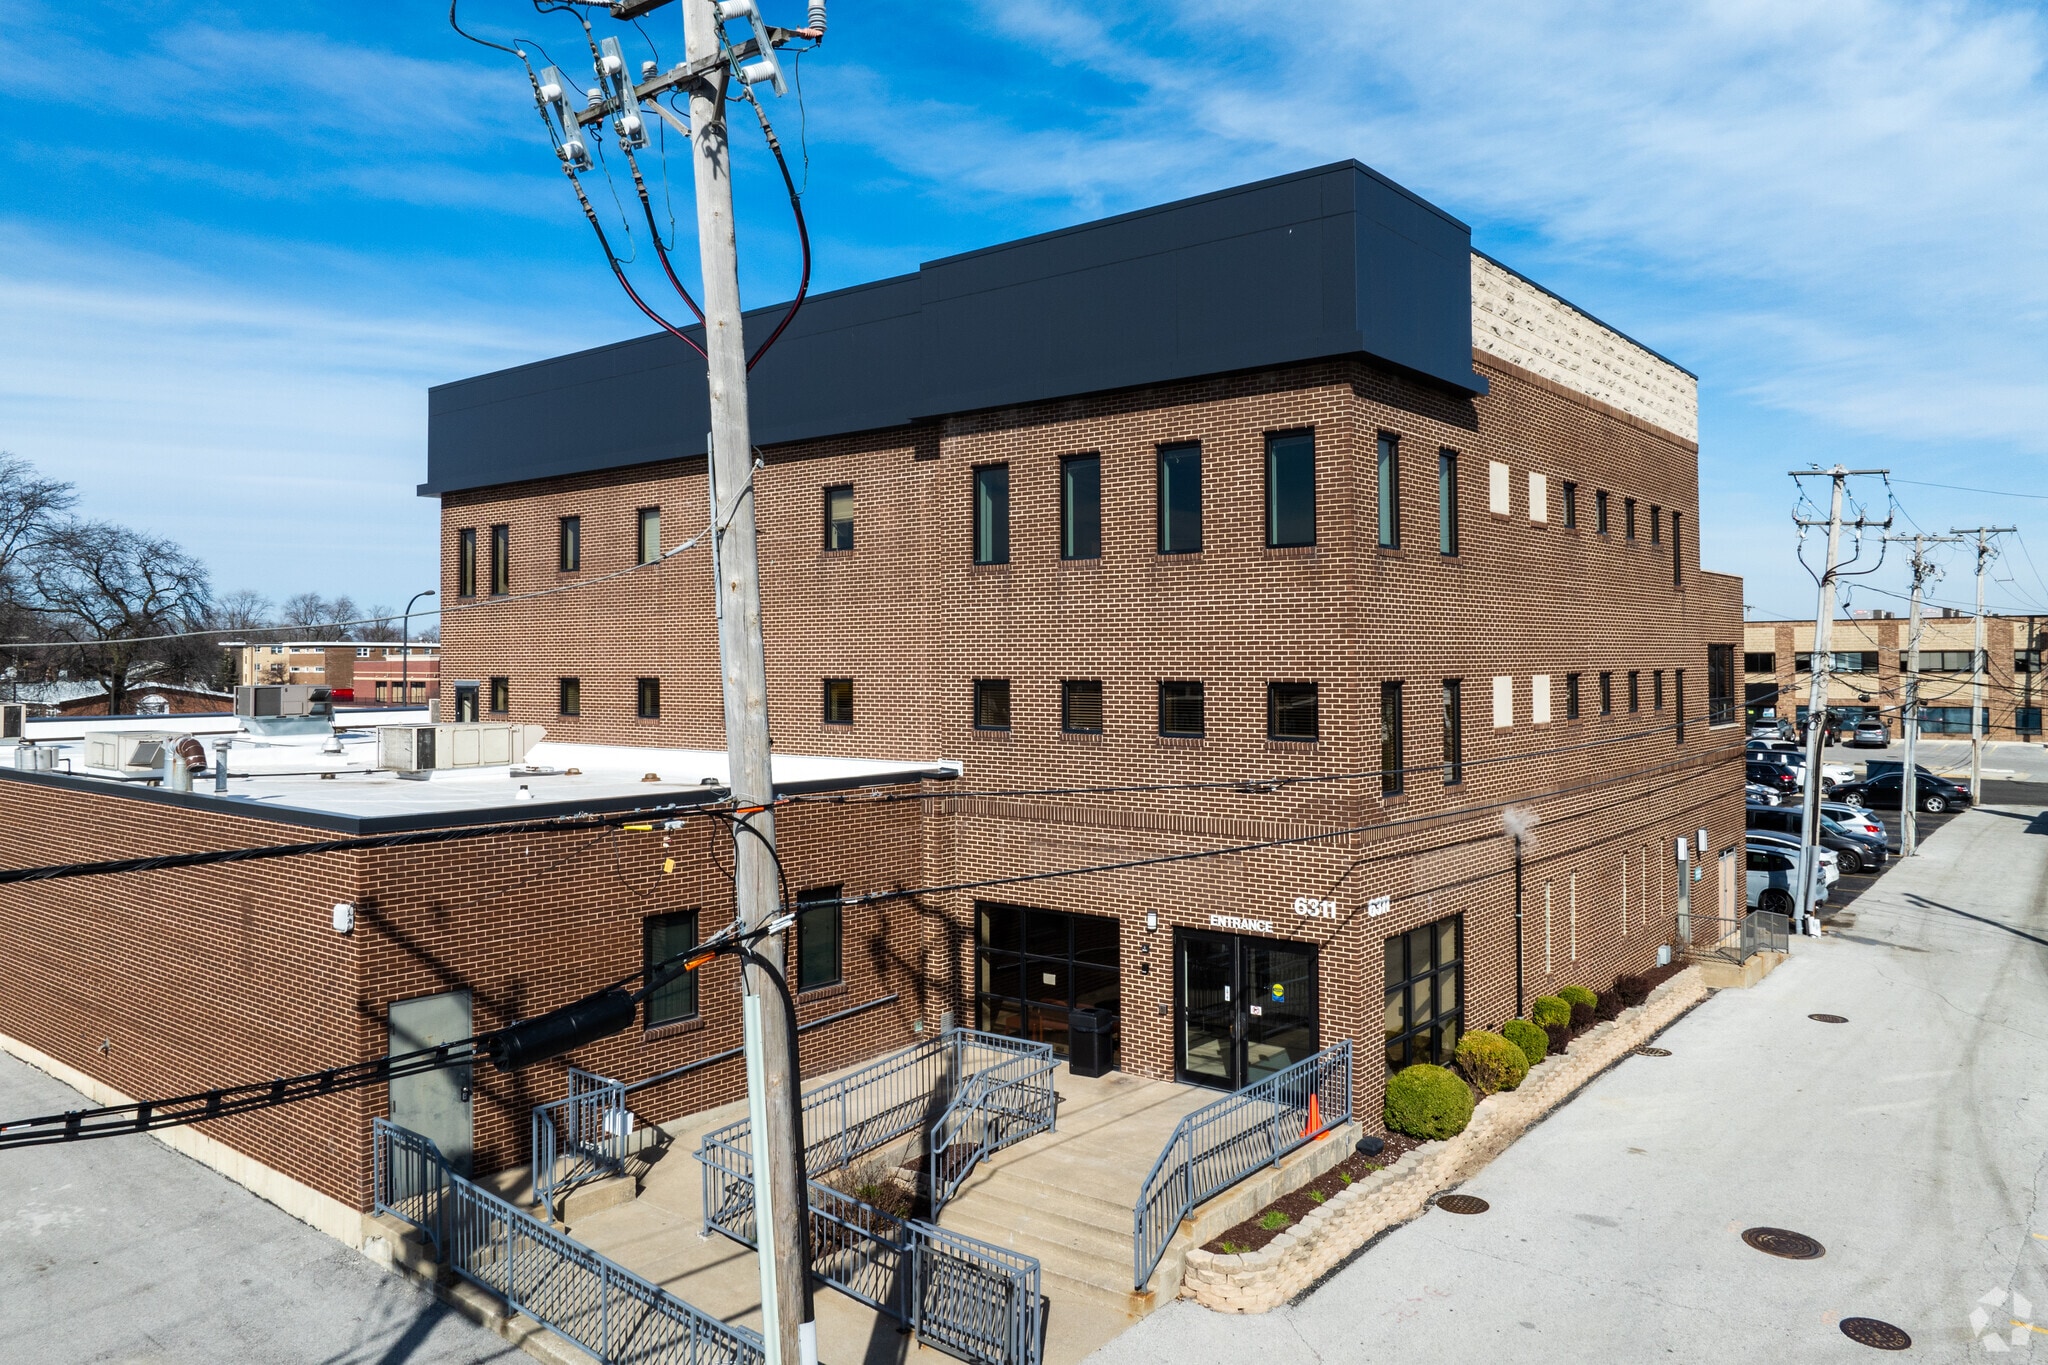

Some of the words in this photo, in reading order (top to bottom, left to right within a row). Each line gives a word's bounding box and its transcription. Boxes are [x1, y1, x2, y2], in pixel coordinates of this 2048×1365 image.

[1294, 897, 1337, 919] 6311
[1368, 895, 1390, 917] 6311
[1210, 914, 1274, 933] ENTRANCE
